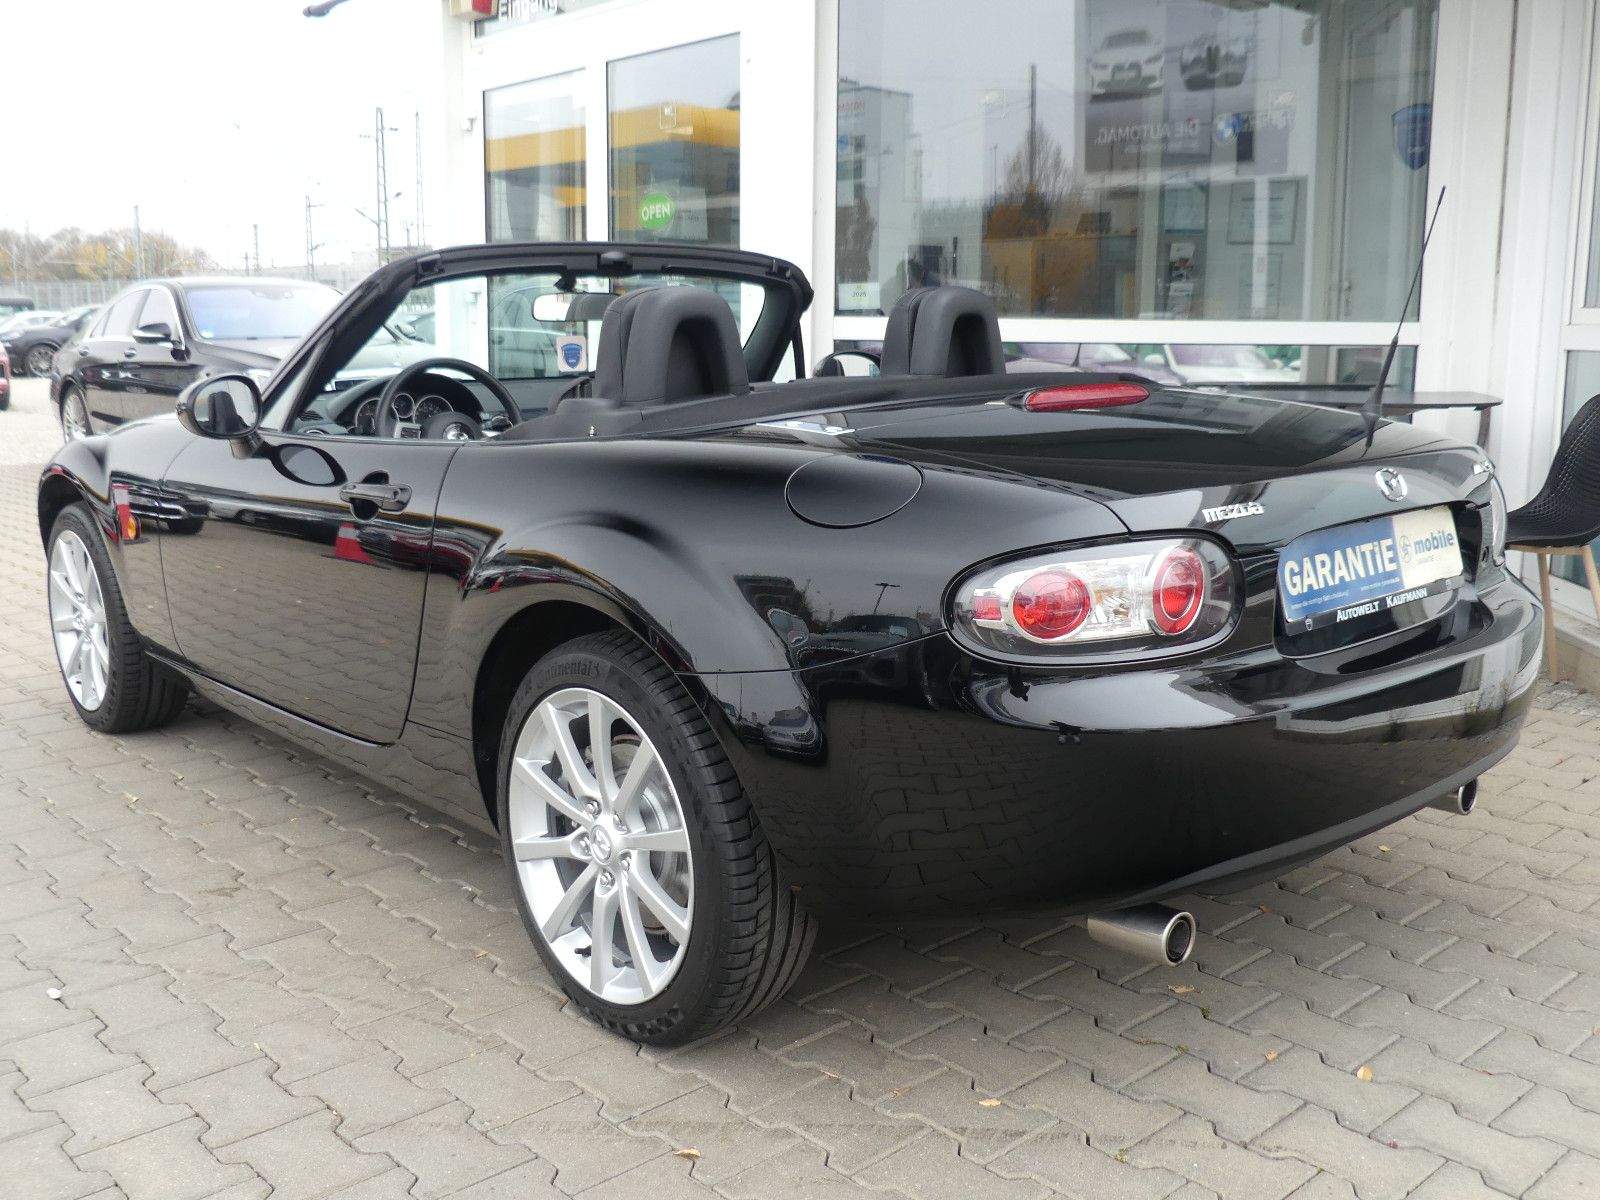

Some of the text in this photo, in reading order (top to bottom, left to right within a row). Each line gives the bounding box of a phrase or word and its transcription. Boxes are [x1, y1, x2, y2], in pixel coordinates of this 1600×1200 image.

[641, 203, 671, 221] OPEN
[1414, 530, 1454, 555] mobile
[1336, 587, 1427, 623] AUTOWELT KAUFMANN
